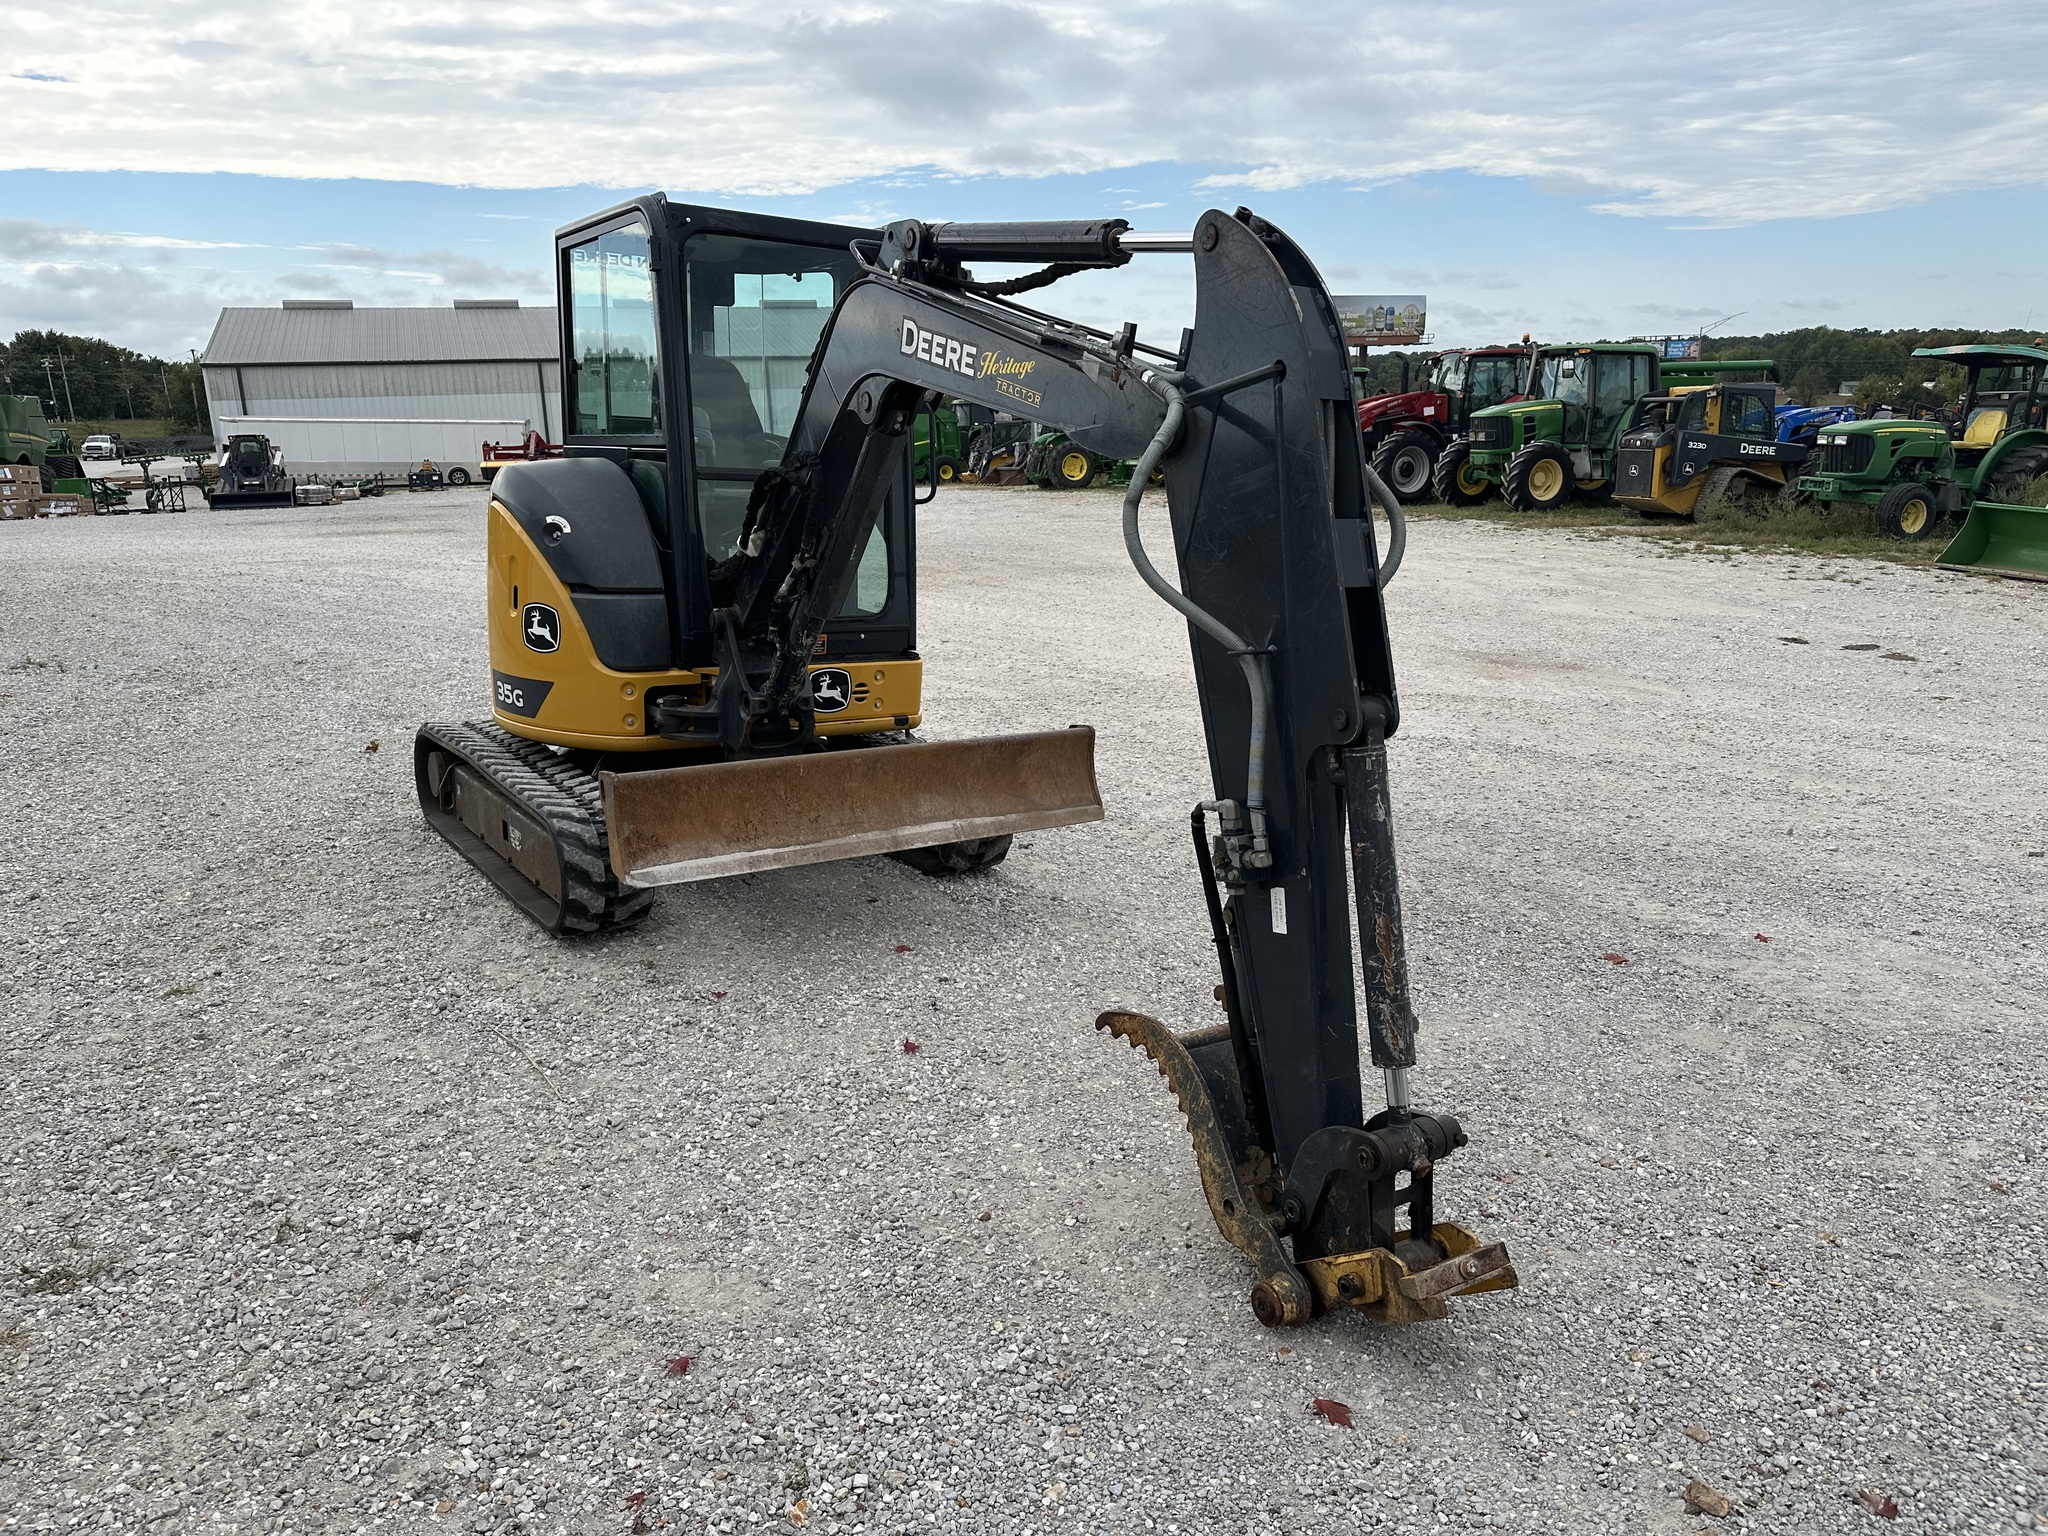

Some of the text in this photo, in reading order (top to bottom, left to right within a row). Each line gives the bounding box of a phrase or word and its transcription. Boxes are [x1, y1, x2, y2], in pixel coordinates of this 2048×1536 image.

[1342, 320, 1356, 328] Here
[900, 318, 977, 377] DEERE
[976, 351, 1036, 380] Heritage
[996, 379, 1041, 406] TRACTOR
[1740, 442, 1777, 455] DEERE
[496, 680, 524, 708] 35G
